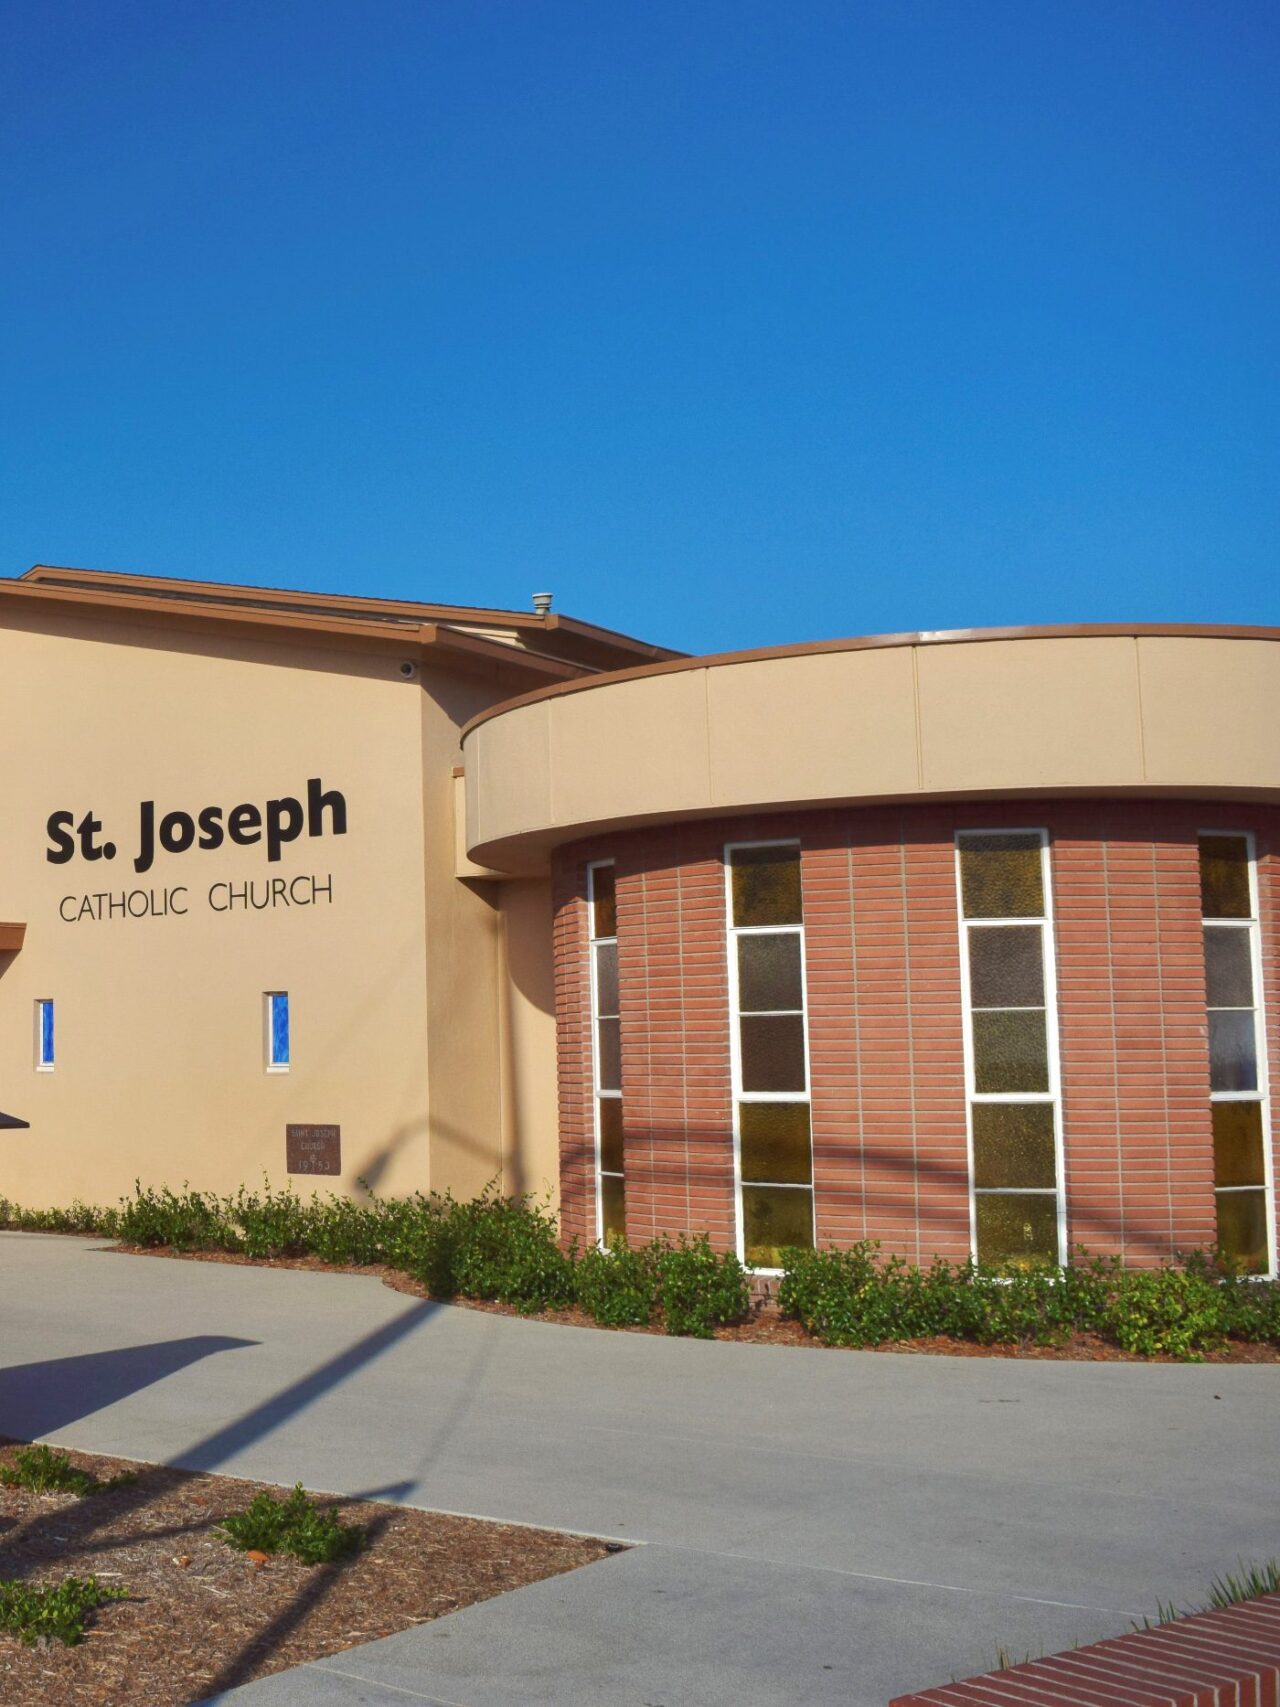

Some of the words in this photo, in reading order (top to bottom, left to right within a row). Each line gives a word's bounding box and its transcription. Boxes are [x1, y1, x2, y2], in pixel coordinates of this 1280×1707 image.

[47, 811, 116, 864] St.
[134, 778, 347, 873] Joseph
[60, 886, 188, 922] CATHOLIC
[208, 874, 332, 911] CHURCH
